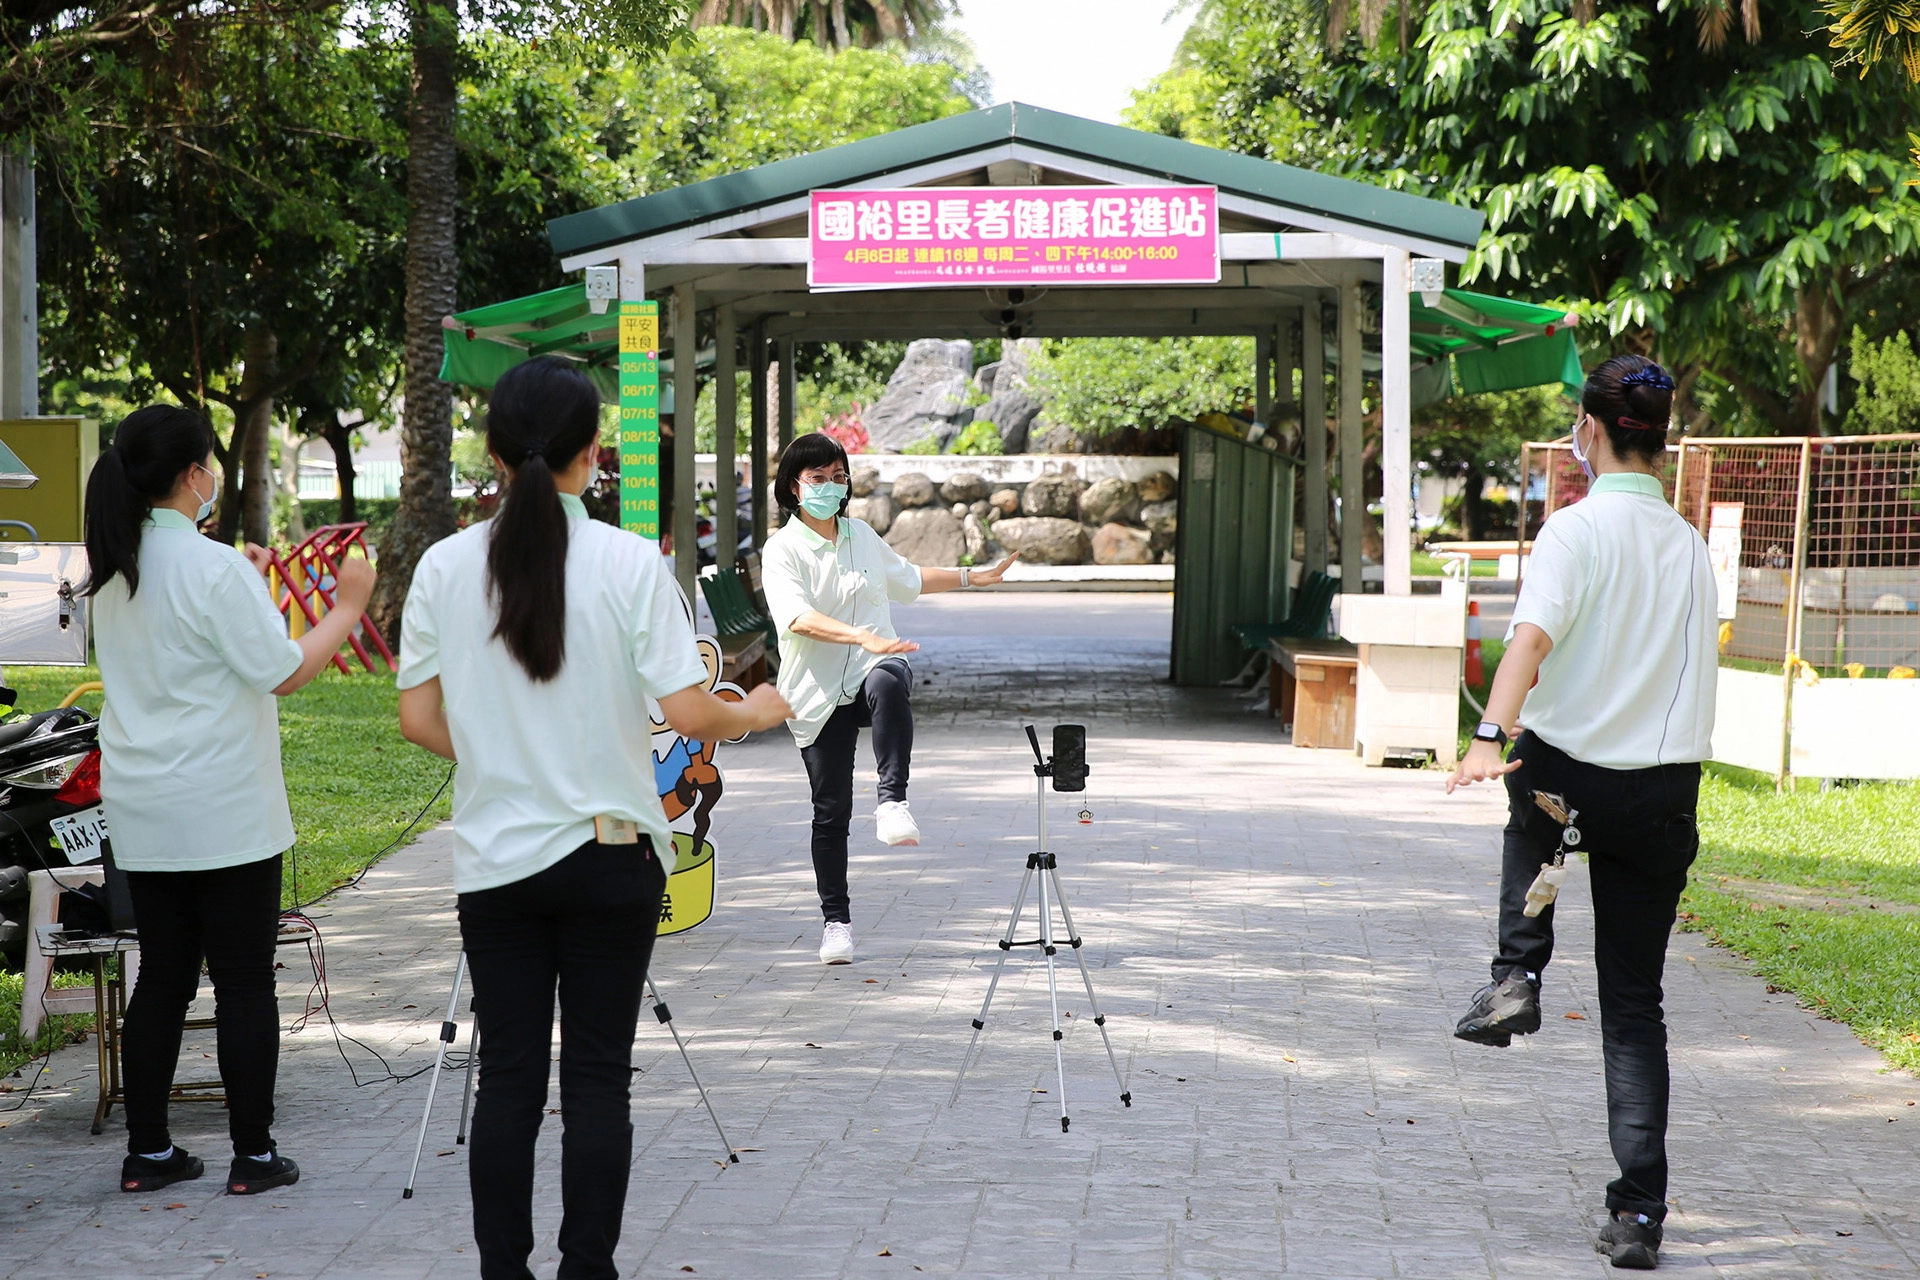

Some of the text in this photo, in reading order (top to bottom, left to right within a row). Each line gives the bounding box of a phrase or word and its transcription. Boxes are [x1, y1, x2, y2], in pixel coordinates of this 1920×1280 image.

[818, 197, 1207, 241] 國裕里長者健康促進站
[844, 247, 909, 264] 4月6日起
[625, 318, 652, 331] 平安
[622, 361, 657, 373] 05/13
[622, 385, 657, 397] 06/17
[622, 408, 657, 420] 07/15
[622, 430, 657, 443] 08/12
[622, 454, 657, 466] 09/16
[622, 477, 657, 489] 10/14
[622, 499, 657, 511] 11/18
